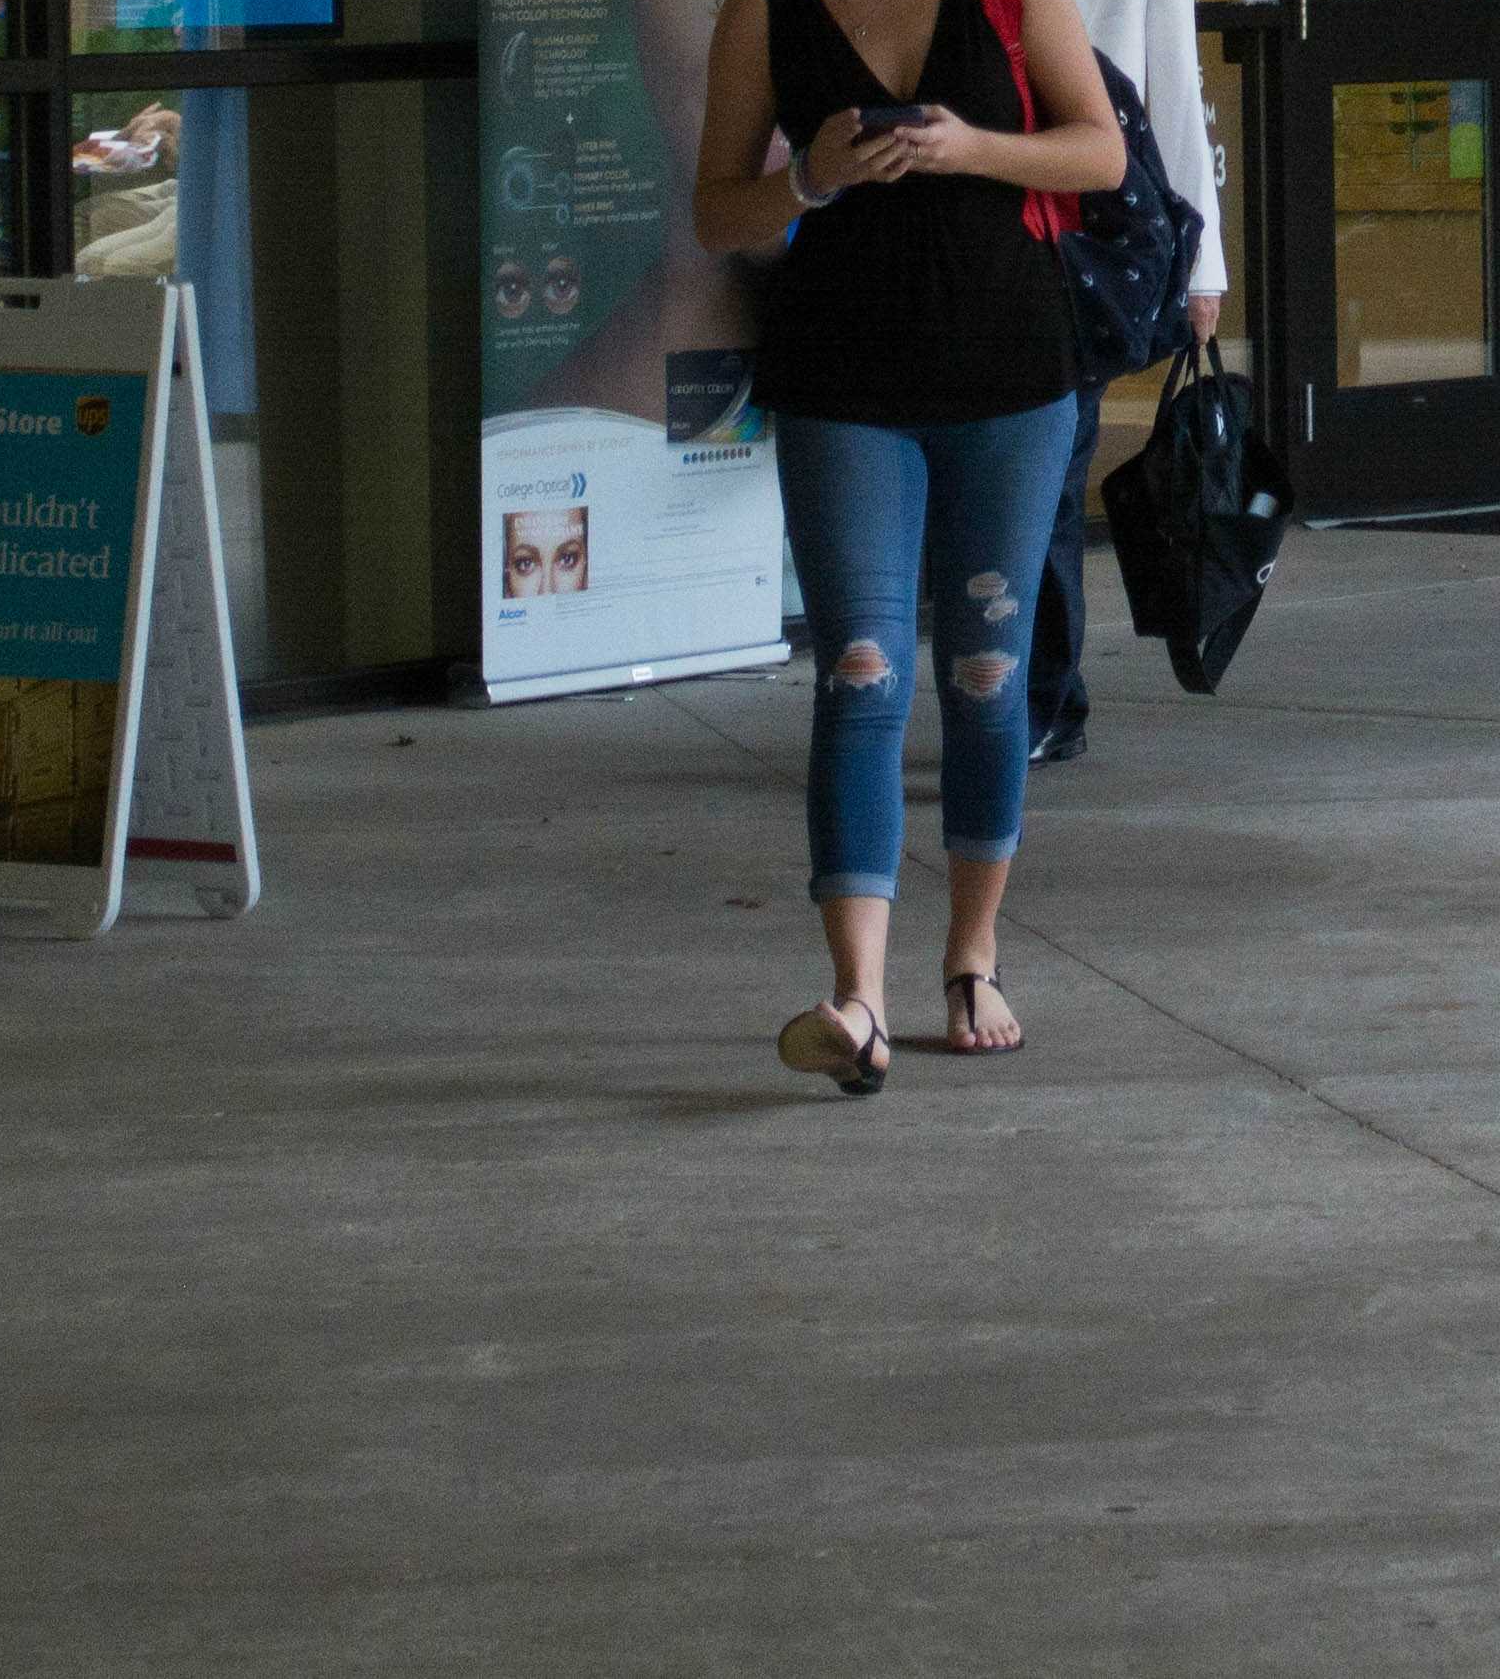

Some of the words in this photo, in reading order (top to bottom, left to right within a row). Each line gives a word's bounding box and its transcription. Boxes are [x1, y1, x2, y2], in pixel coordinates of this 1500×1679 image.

[497, 483, 534, 500] College
[536, 479, 570, 497] Optical
[40, 621, 63, 642] all
[66, 624, 98, 644] out
